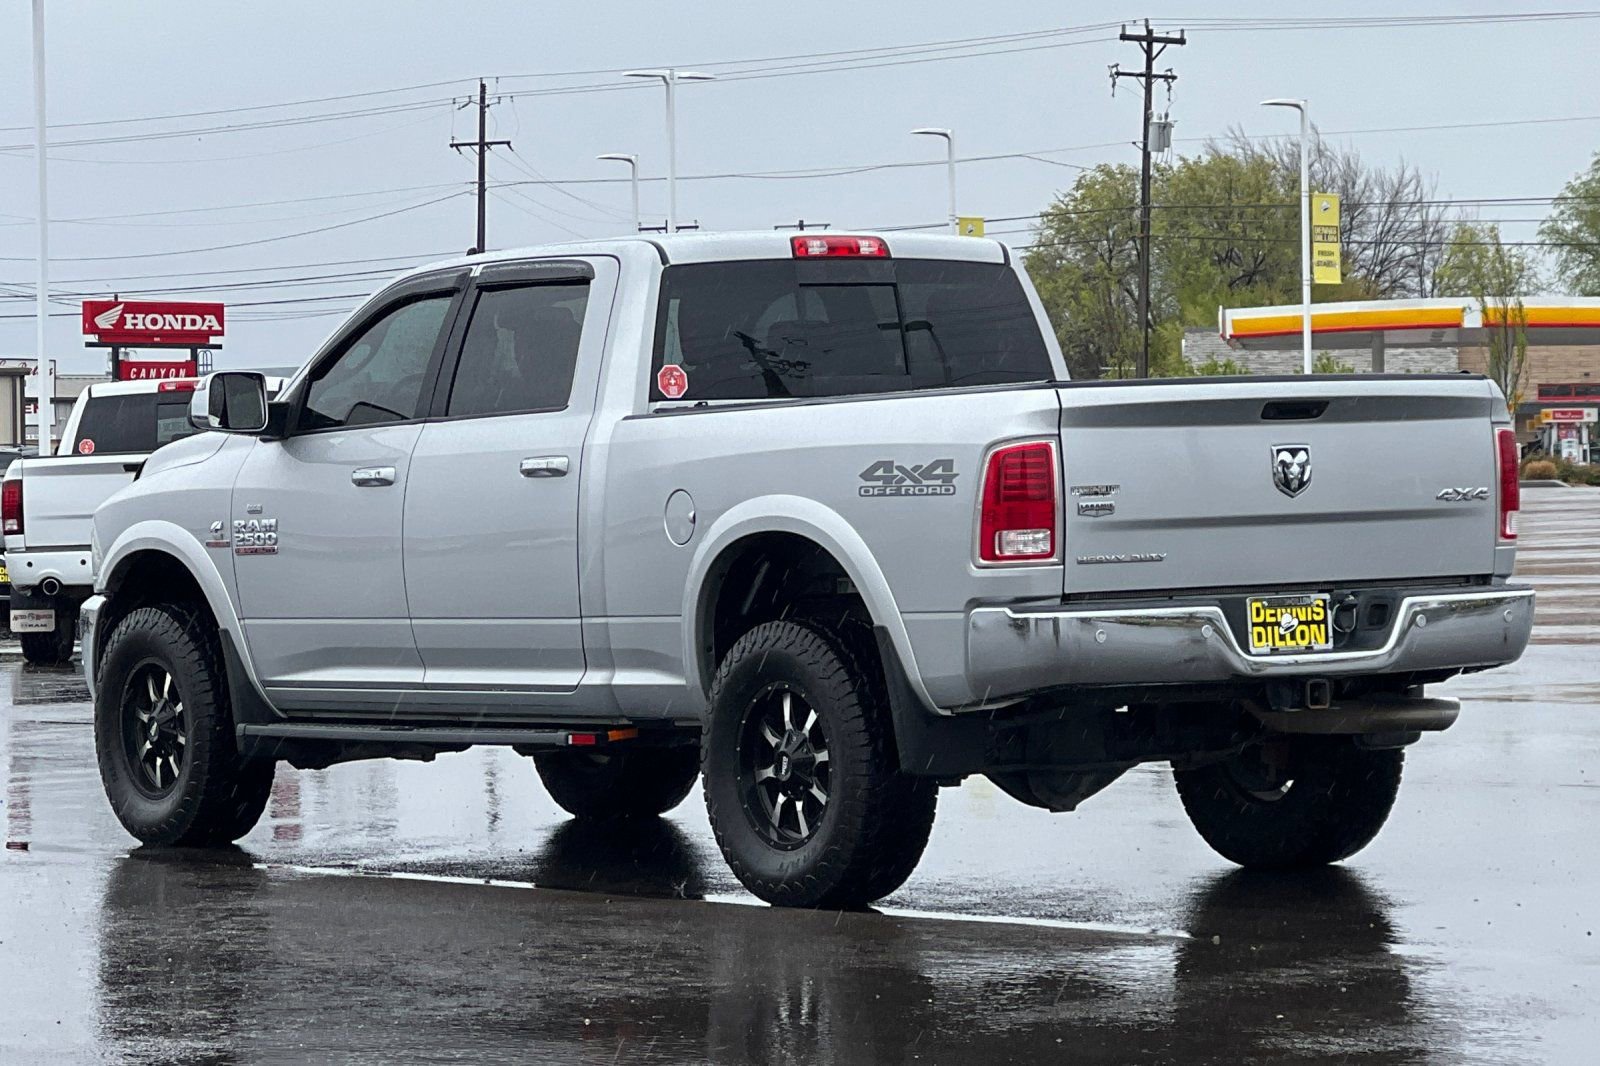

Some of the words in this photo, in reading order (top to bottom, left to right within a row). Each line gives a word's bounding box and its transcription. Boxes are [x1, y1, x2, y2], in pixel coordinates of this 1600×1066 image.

[124, 314, 222, 330] HONDA
[130, 368, 186, 379] CANYON
[860, 486, 897, 495] OFF
[901, 486, 955, 495] ROAD
[234, 519, 278, 533] RAM
[234, 532, 278, 547] 2500
[1251, 599, 1325, 622] DENNIS
[1252, 624, 1326, 647] DILLON
